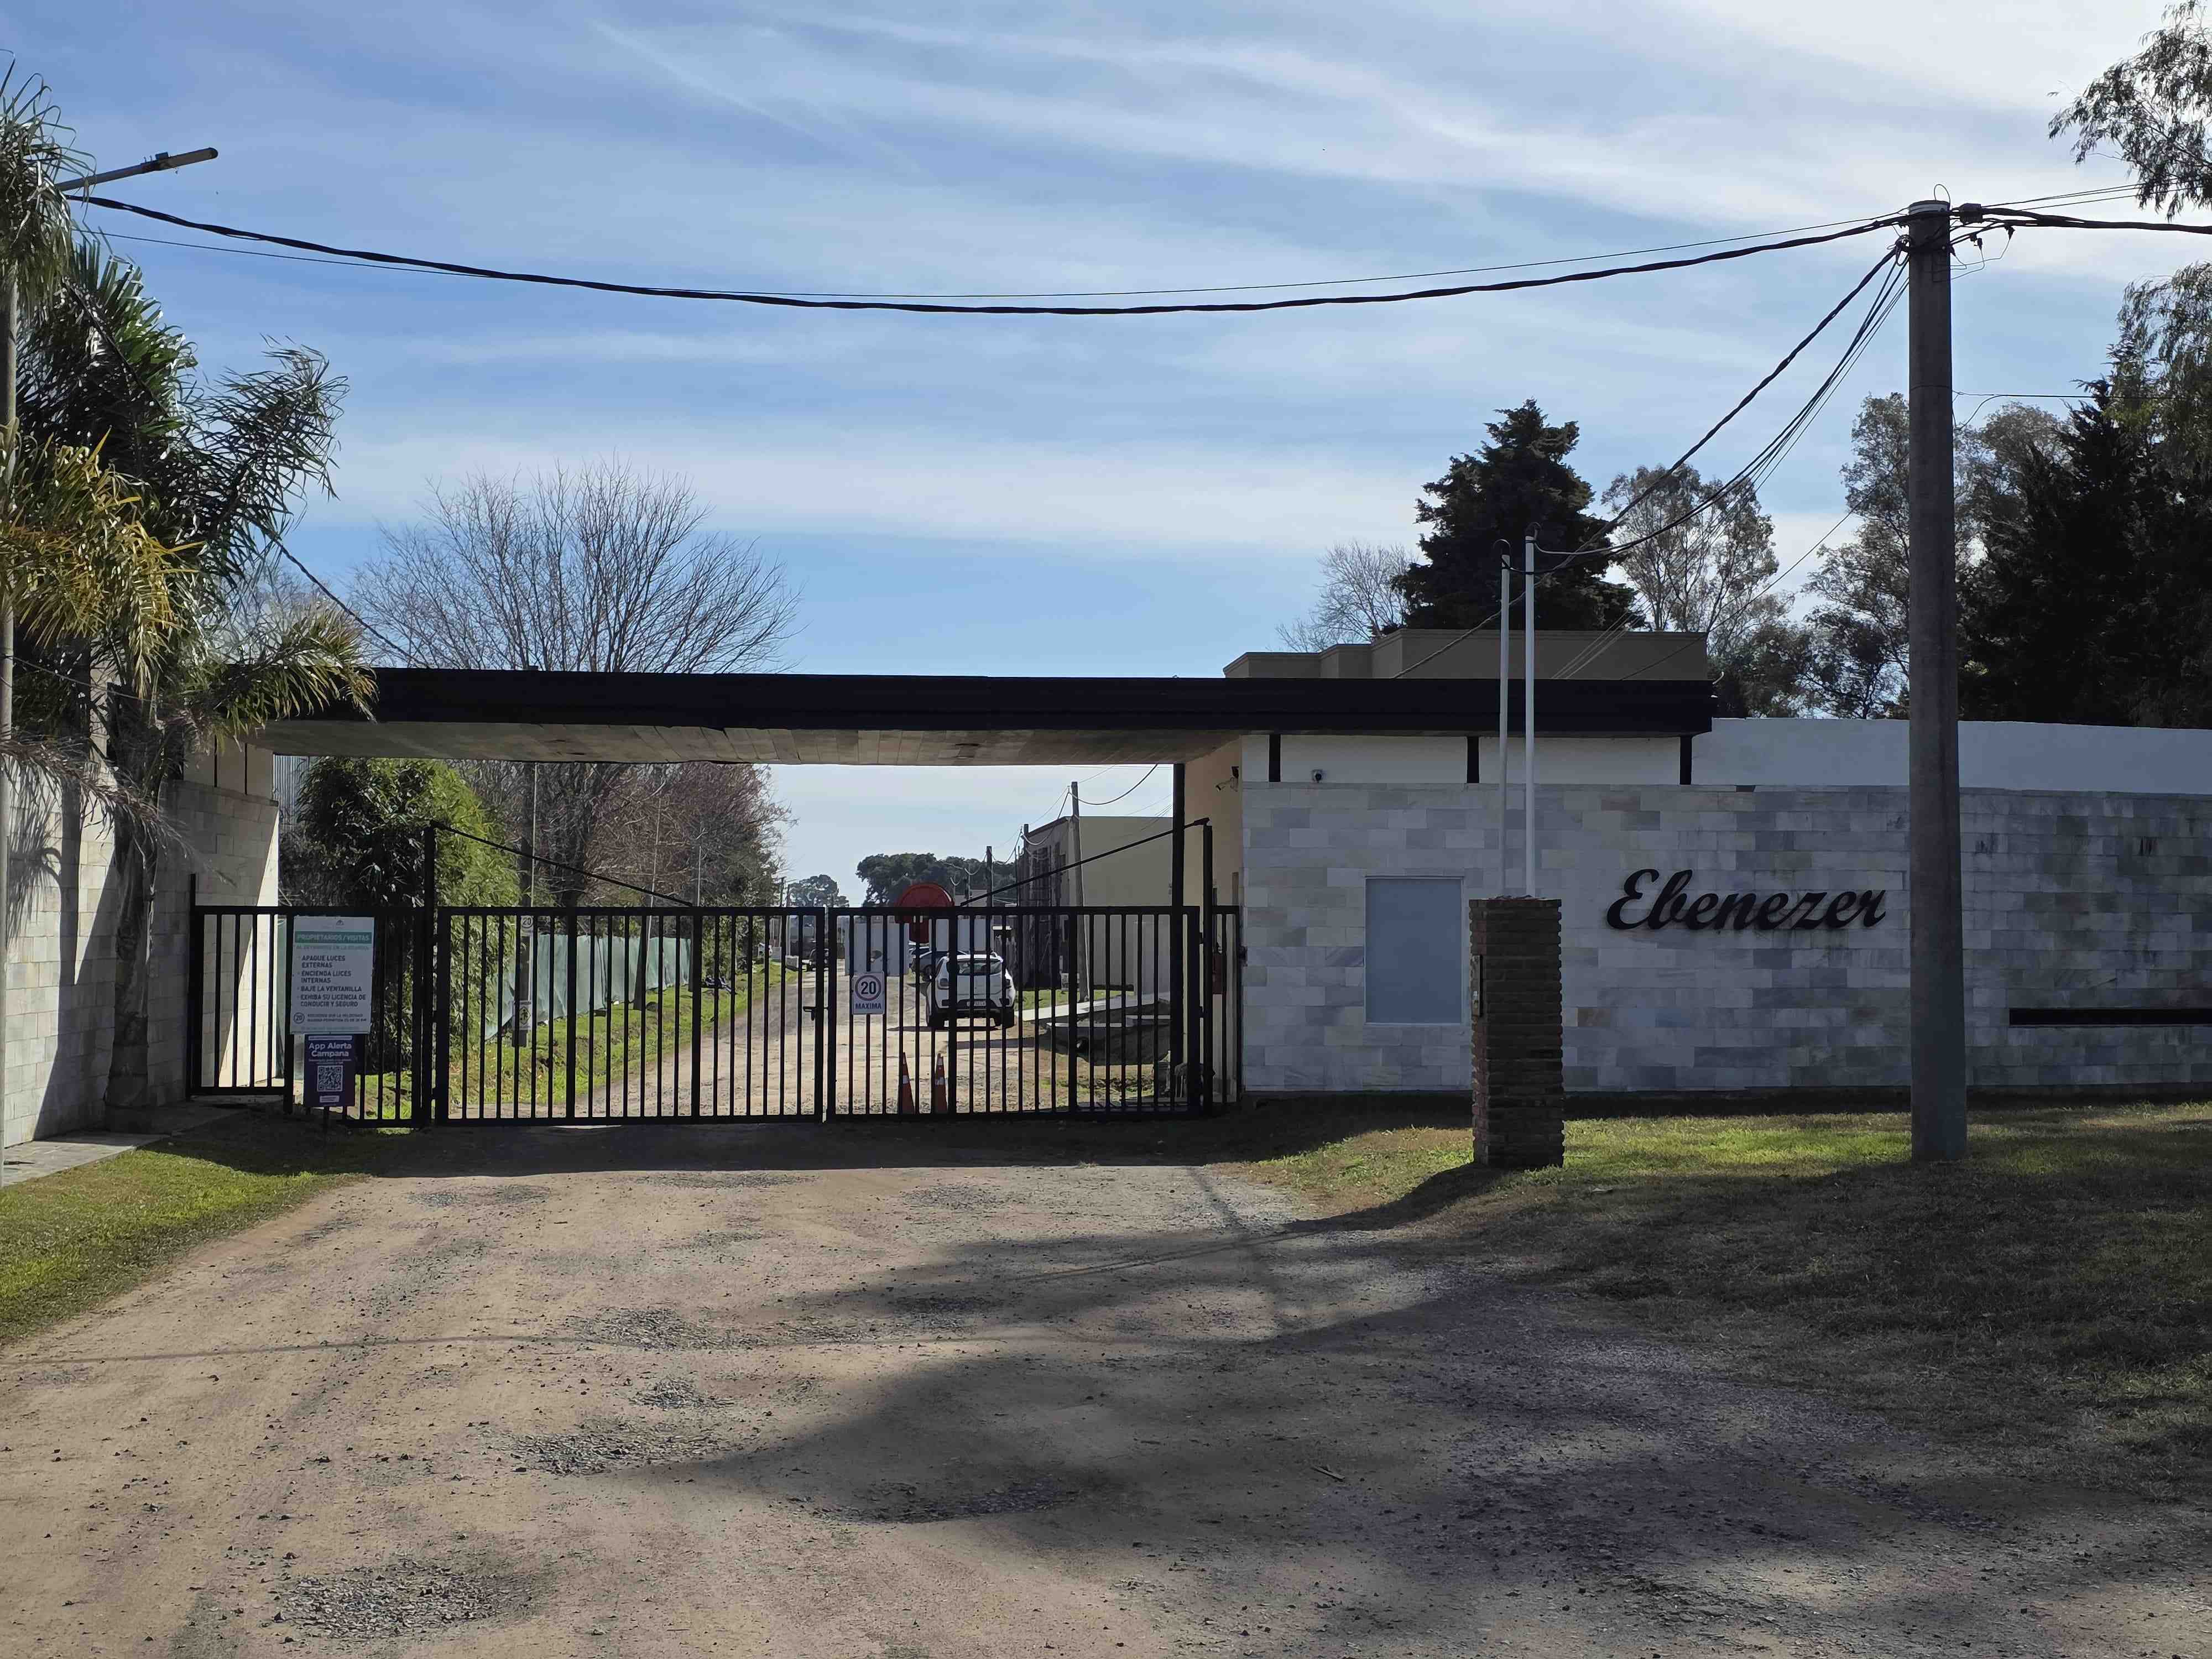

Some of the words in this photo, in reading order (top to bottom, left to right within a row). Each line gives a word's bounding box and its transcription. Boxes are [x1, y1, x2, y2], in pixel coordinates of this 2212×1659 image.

[1606, 869, 1886, 930] Ebenezer
[861, 981, 877, 994] 20
[309, 1042, 326, 1051] App
